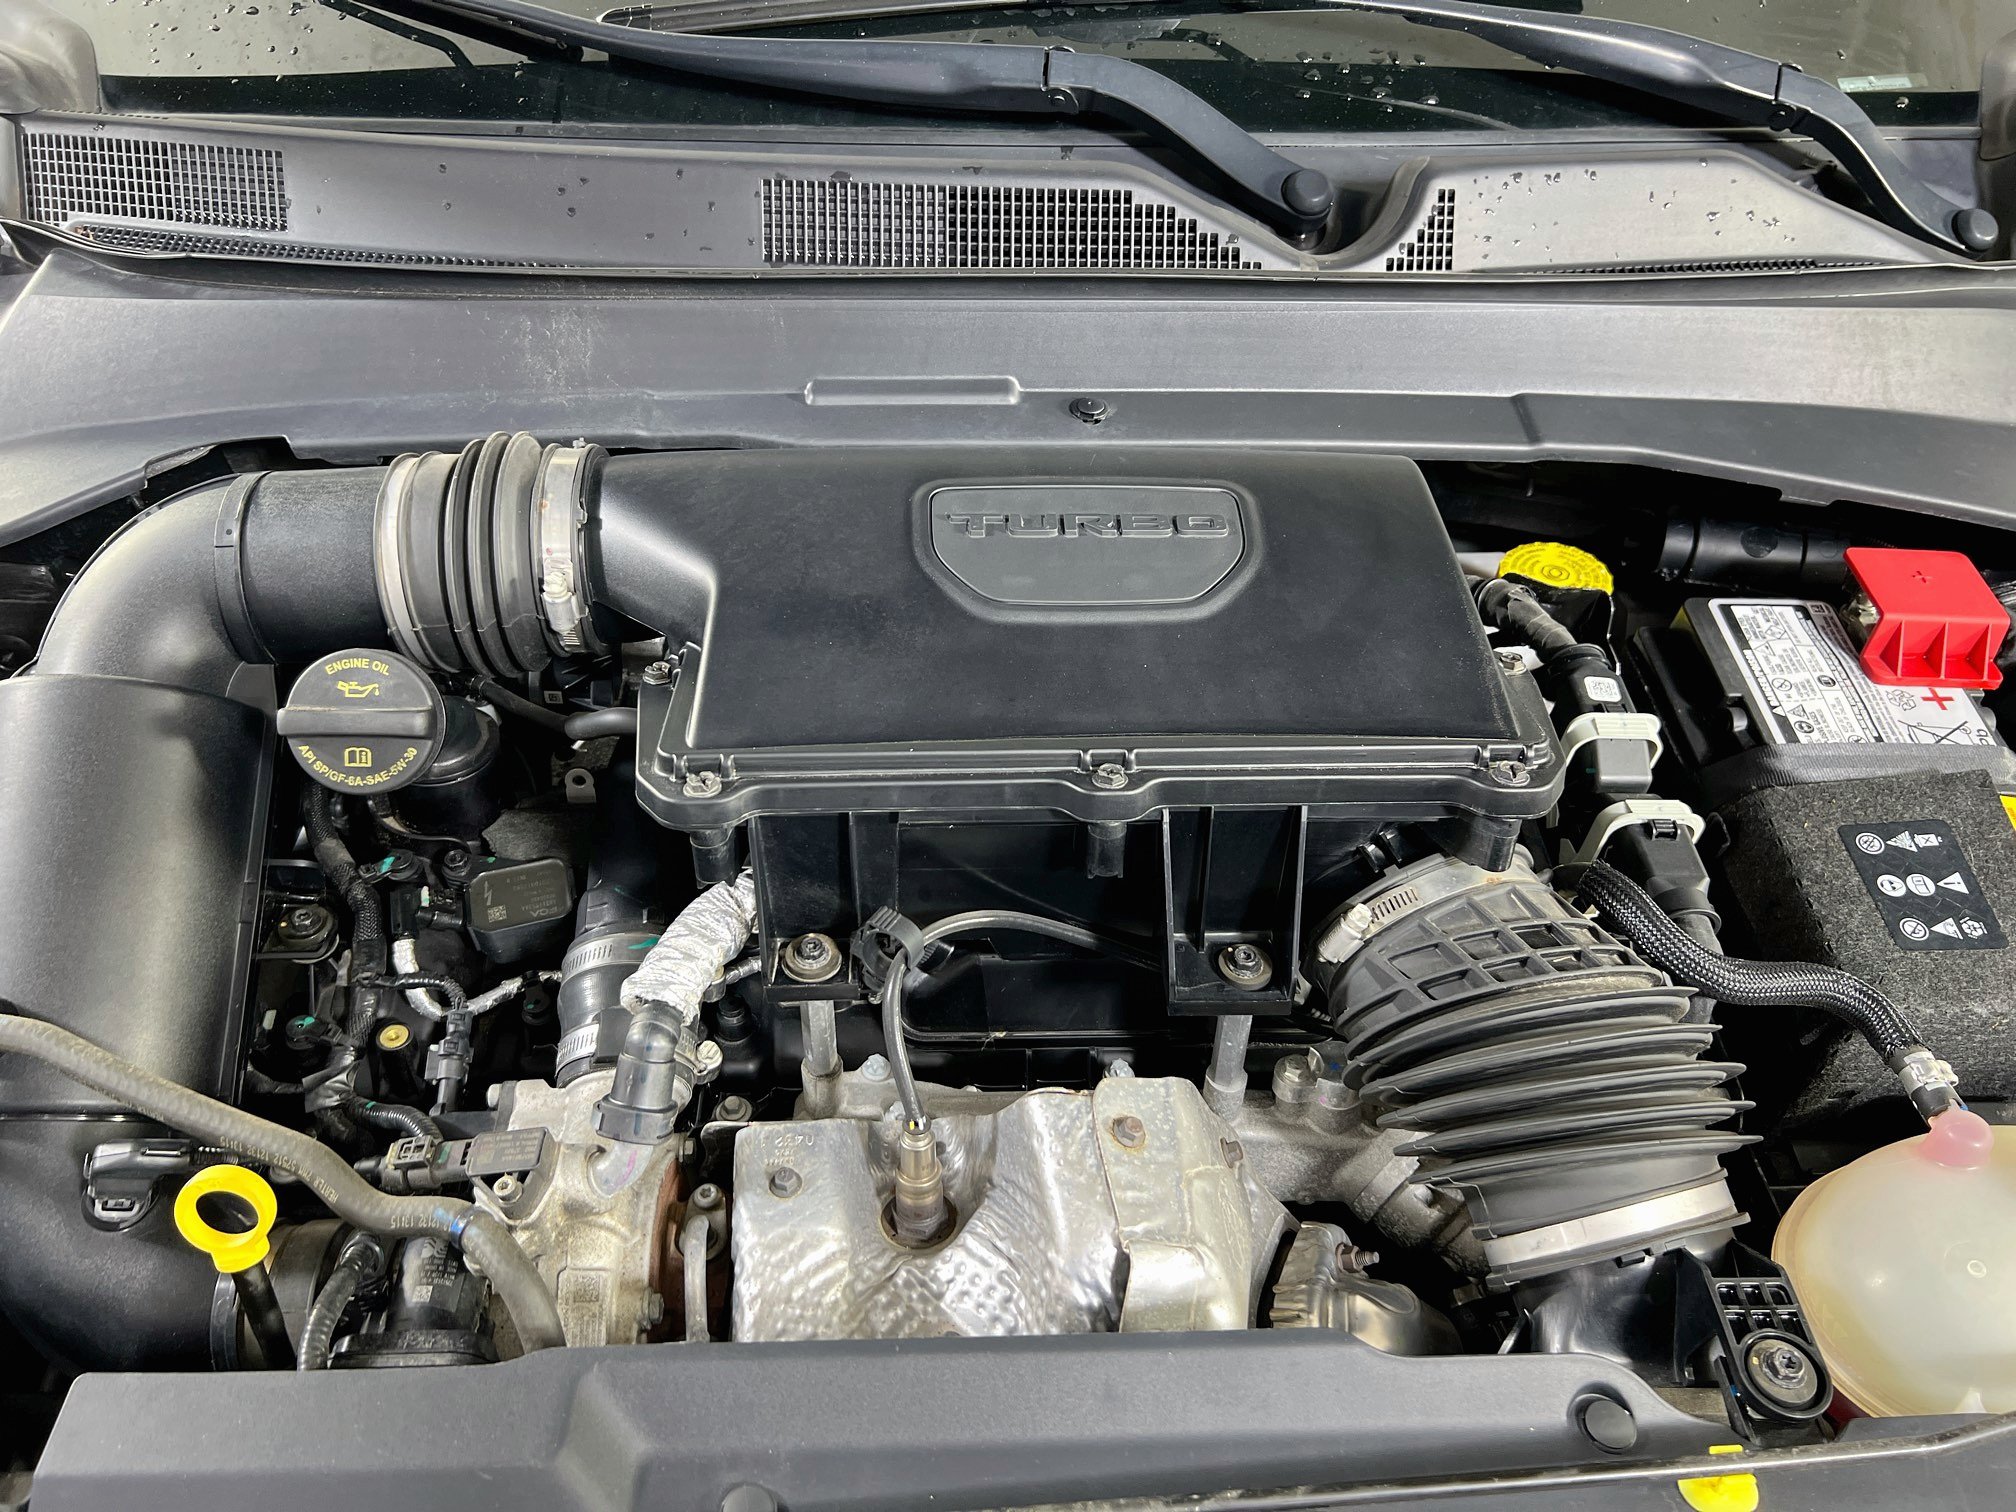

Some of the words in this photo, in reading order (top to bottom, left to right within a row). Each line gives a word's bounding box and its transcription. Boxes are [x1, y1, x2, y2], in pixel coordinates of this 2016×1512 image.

[946, 513, 1229, 538] TURBO
[325, 658, 370, 675] ENGINE
[372, 659, 390, 676] OIL
[298, 745, 315, 764] API
[313, 1176, 339, 1204] HEATER
